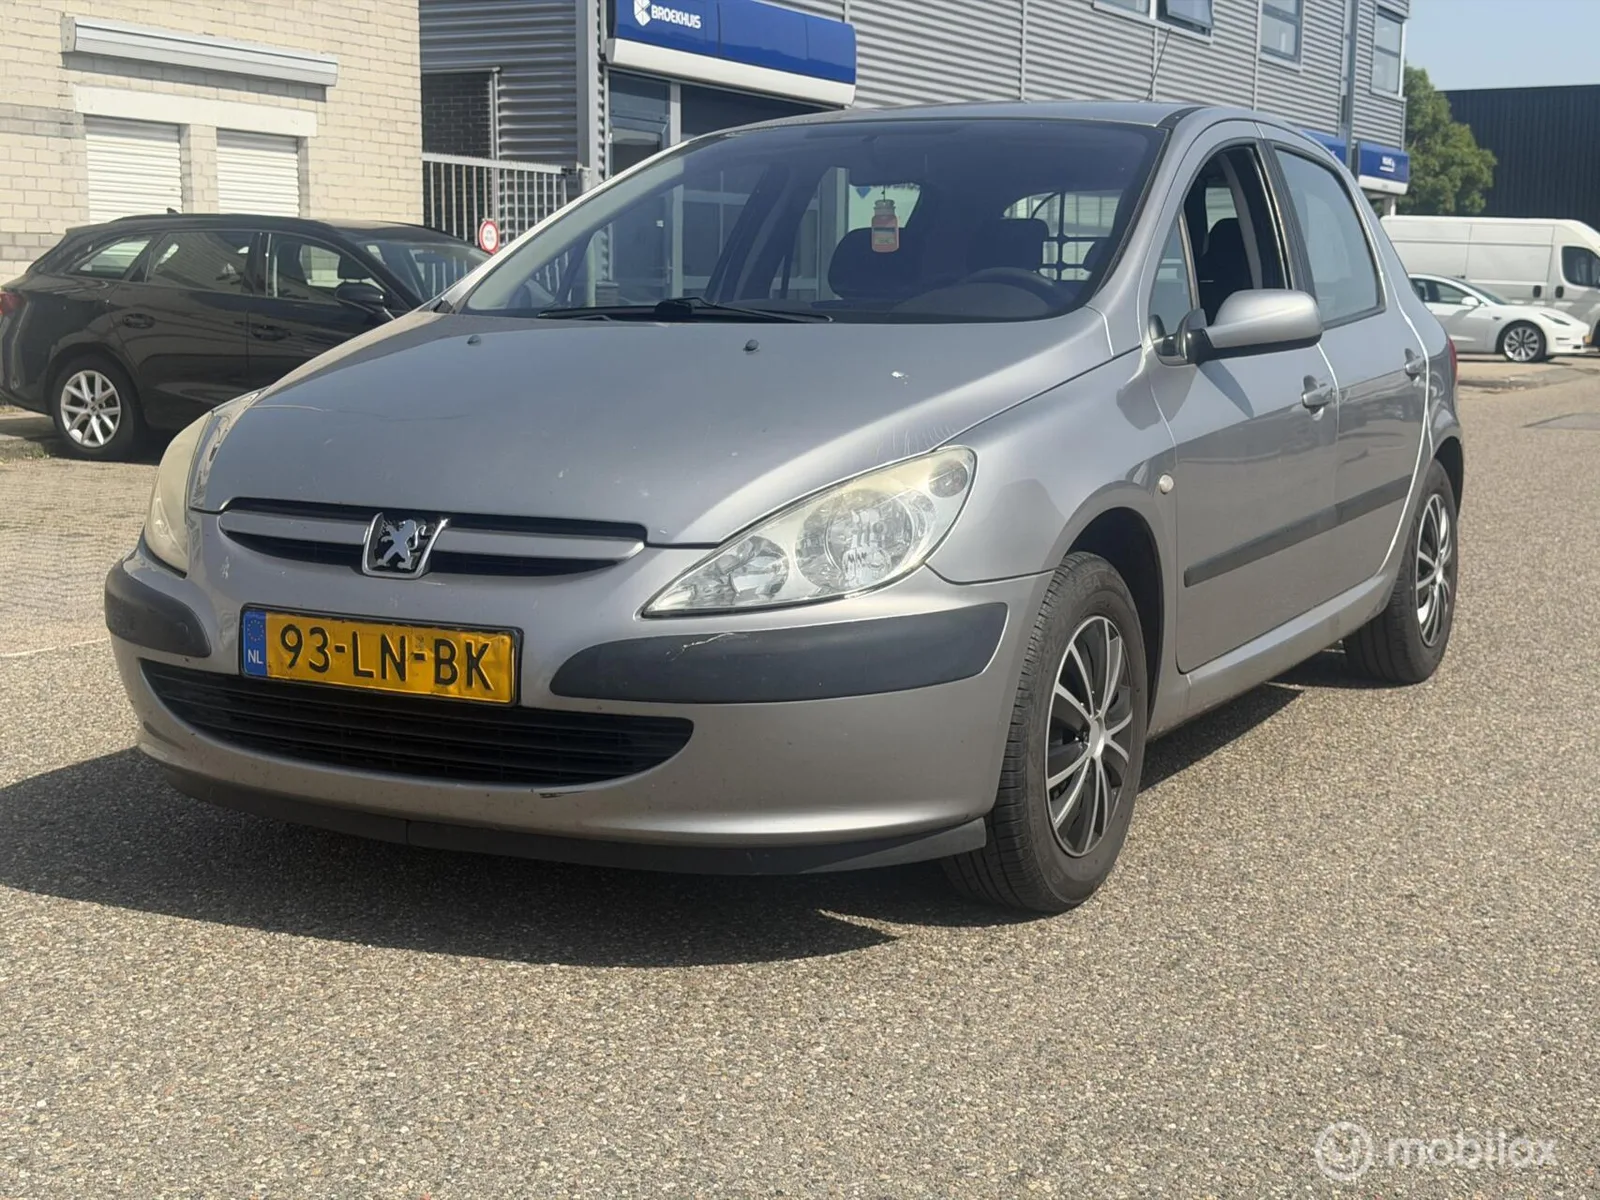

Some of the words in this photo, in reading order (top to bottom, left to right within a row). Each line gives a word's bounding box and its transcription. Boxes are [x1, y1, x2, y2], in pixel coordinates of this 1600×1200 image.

[651, 5, 701, 29] BROEKHUIS
[248, 649, 264, 665] NL
[280, 624, 494, 691] 93-LN-BK
